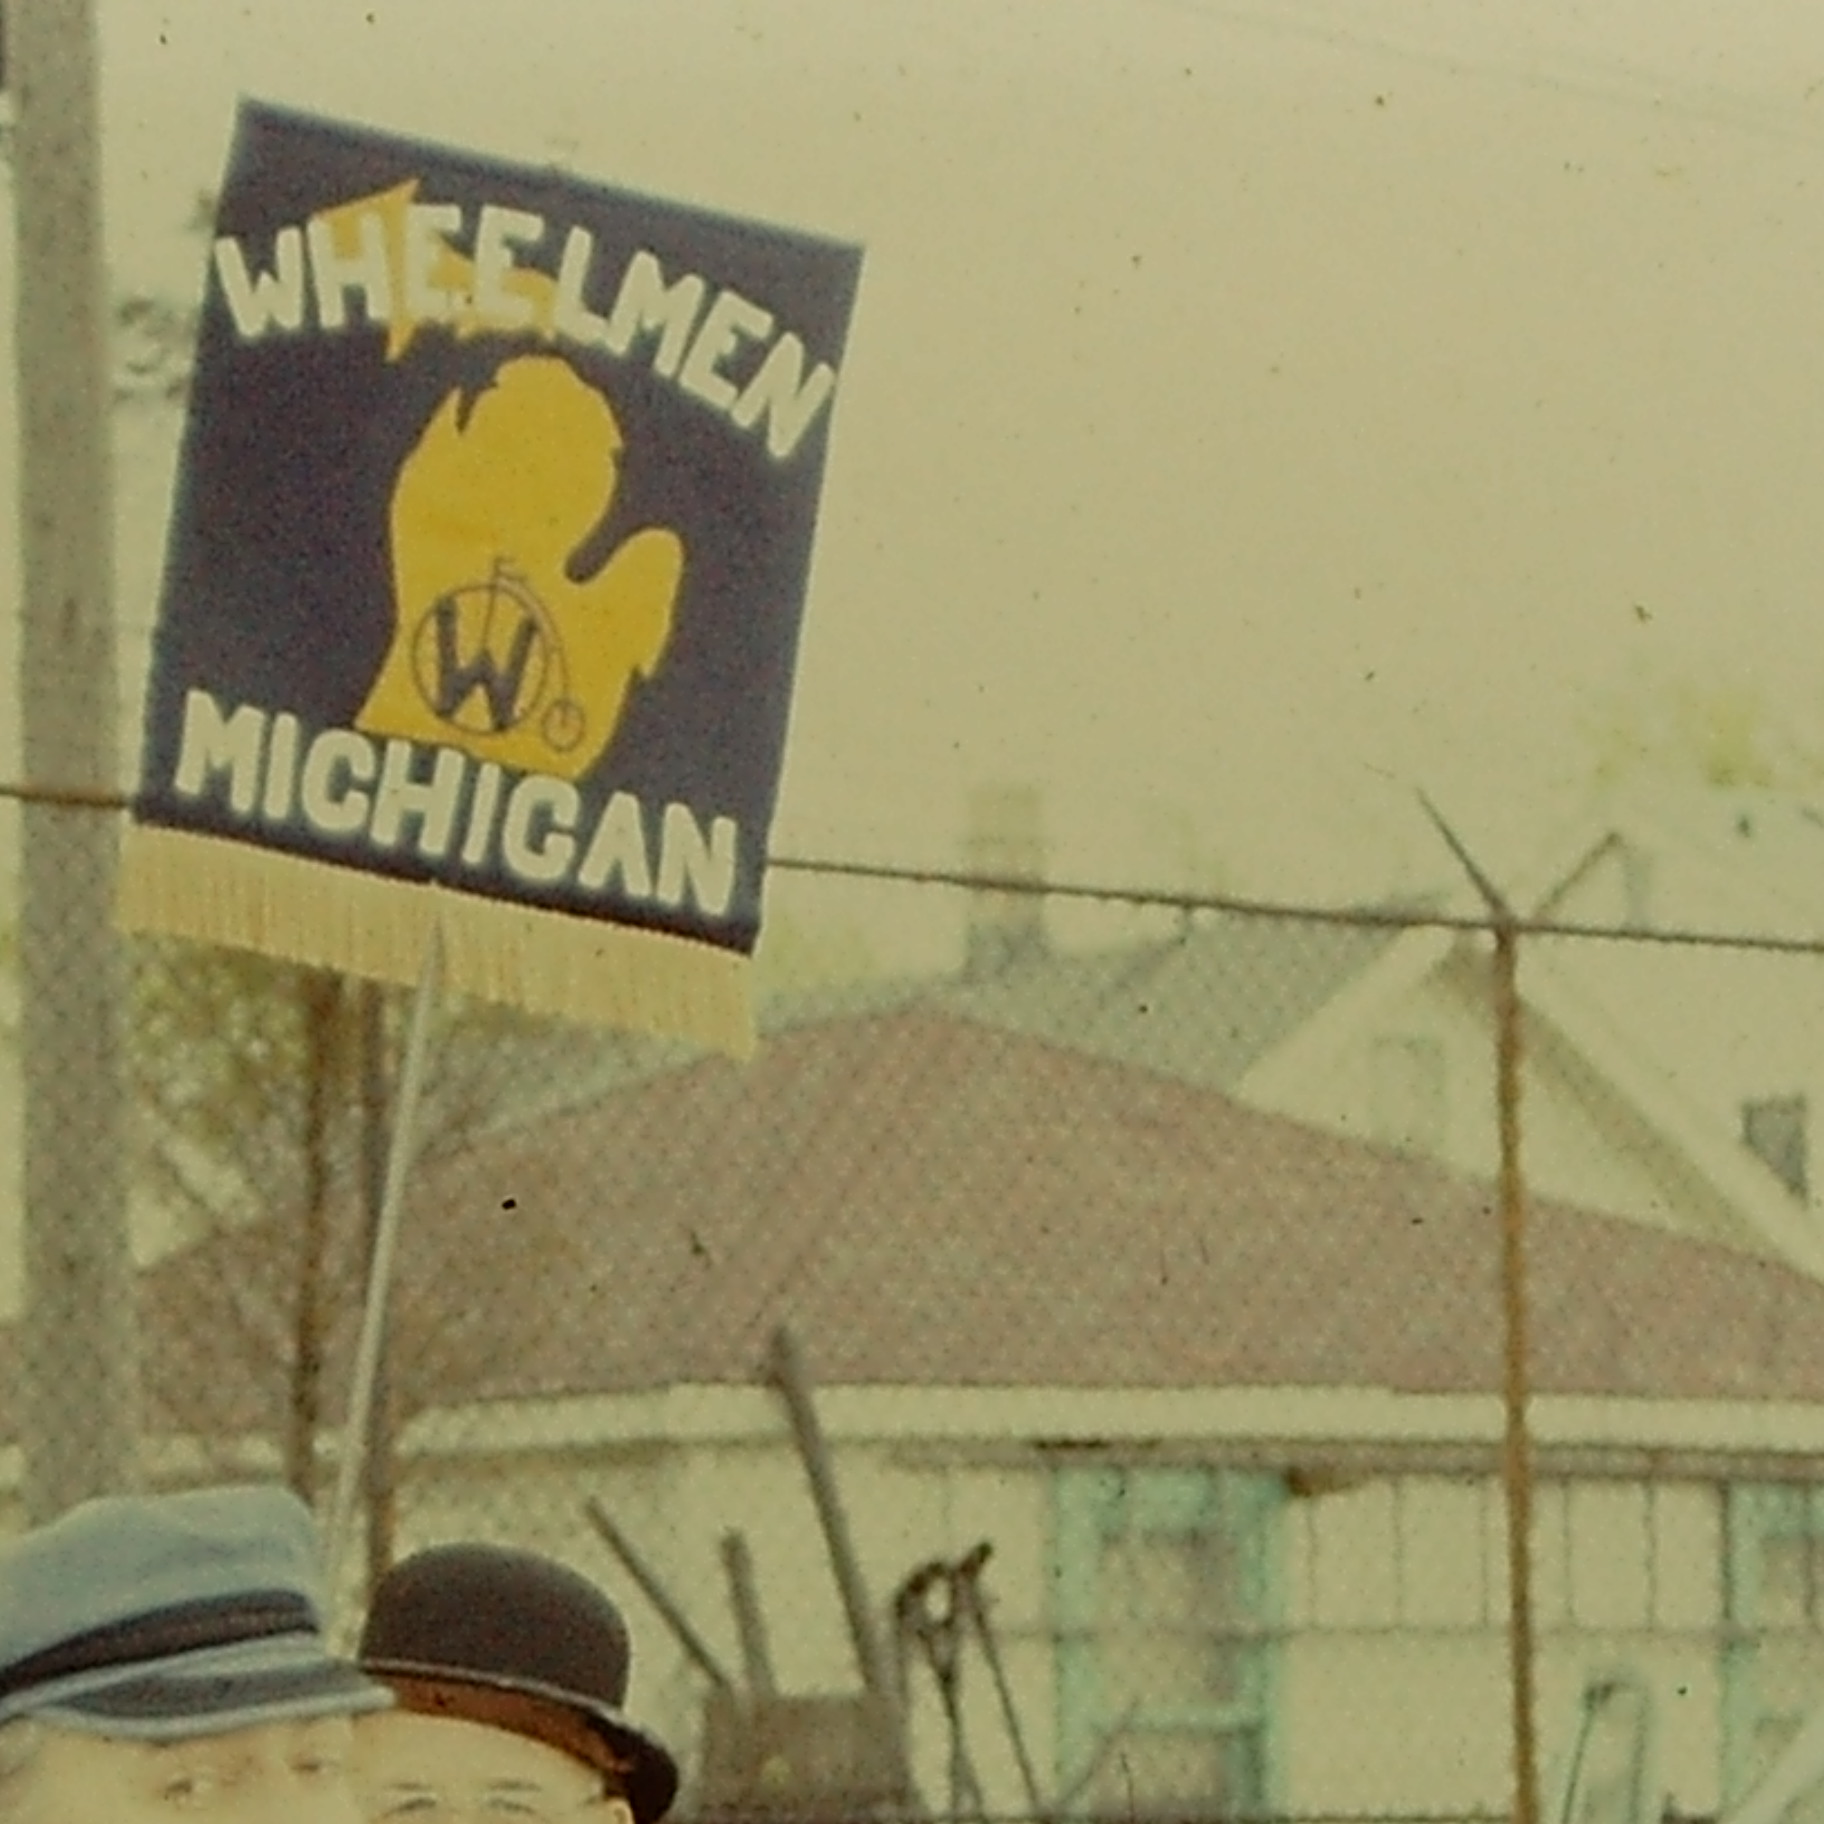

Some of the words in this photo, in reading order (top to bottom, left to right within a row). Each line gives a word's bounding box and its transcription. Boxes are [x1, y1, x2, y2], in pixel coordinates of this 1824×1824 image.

[215, 204, 834, 457] WHEELMEN
[434, 597, 538, 732] W
[174, 689, 738, 916] MICHIGAN
